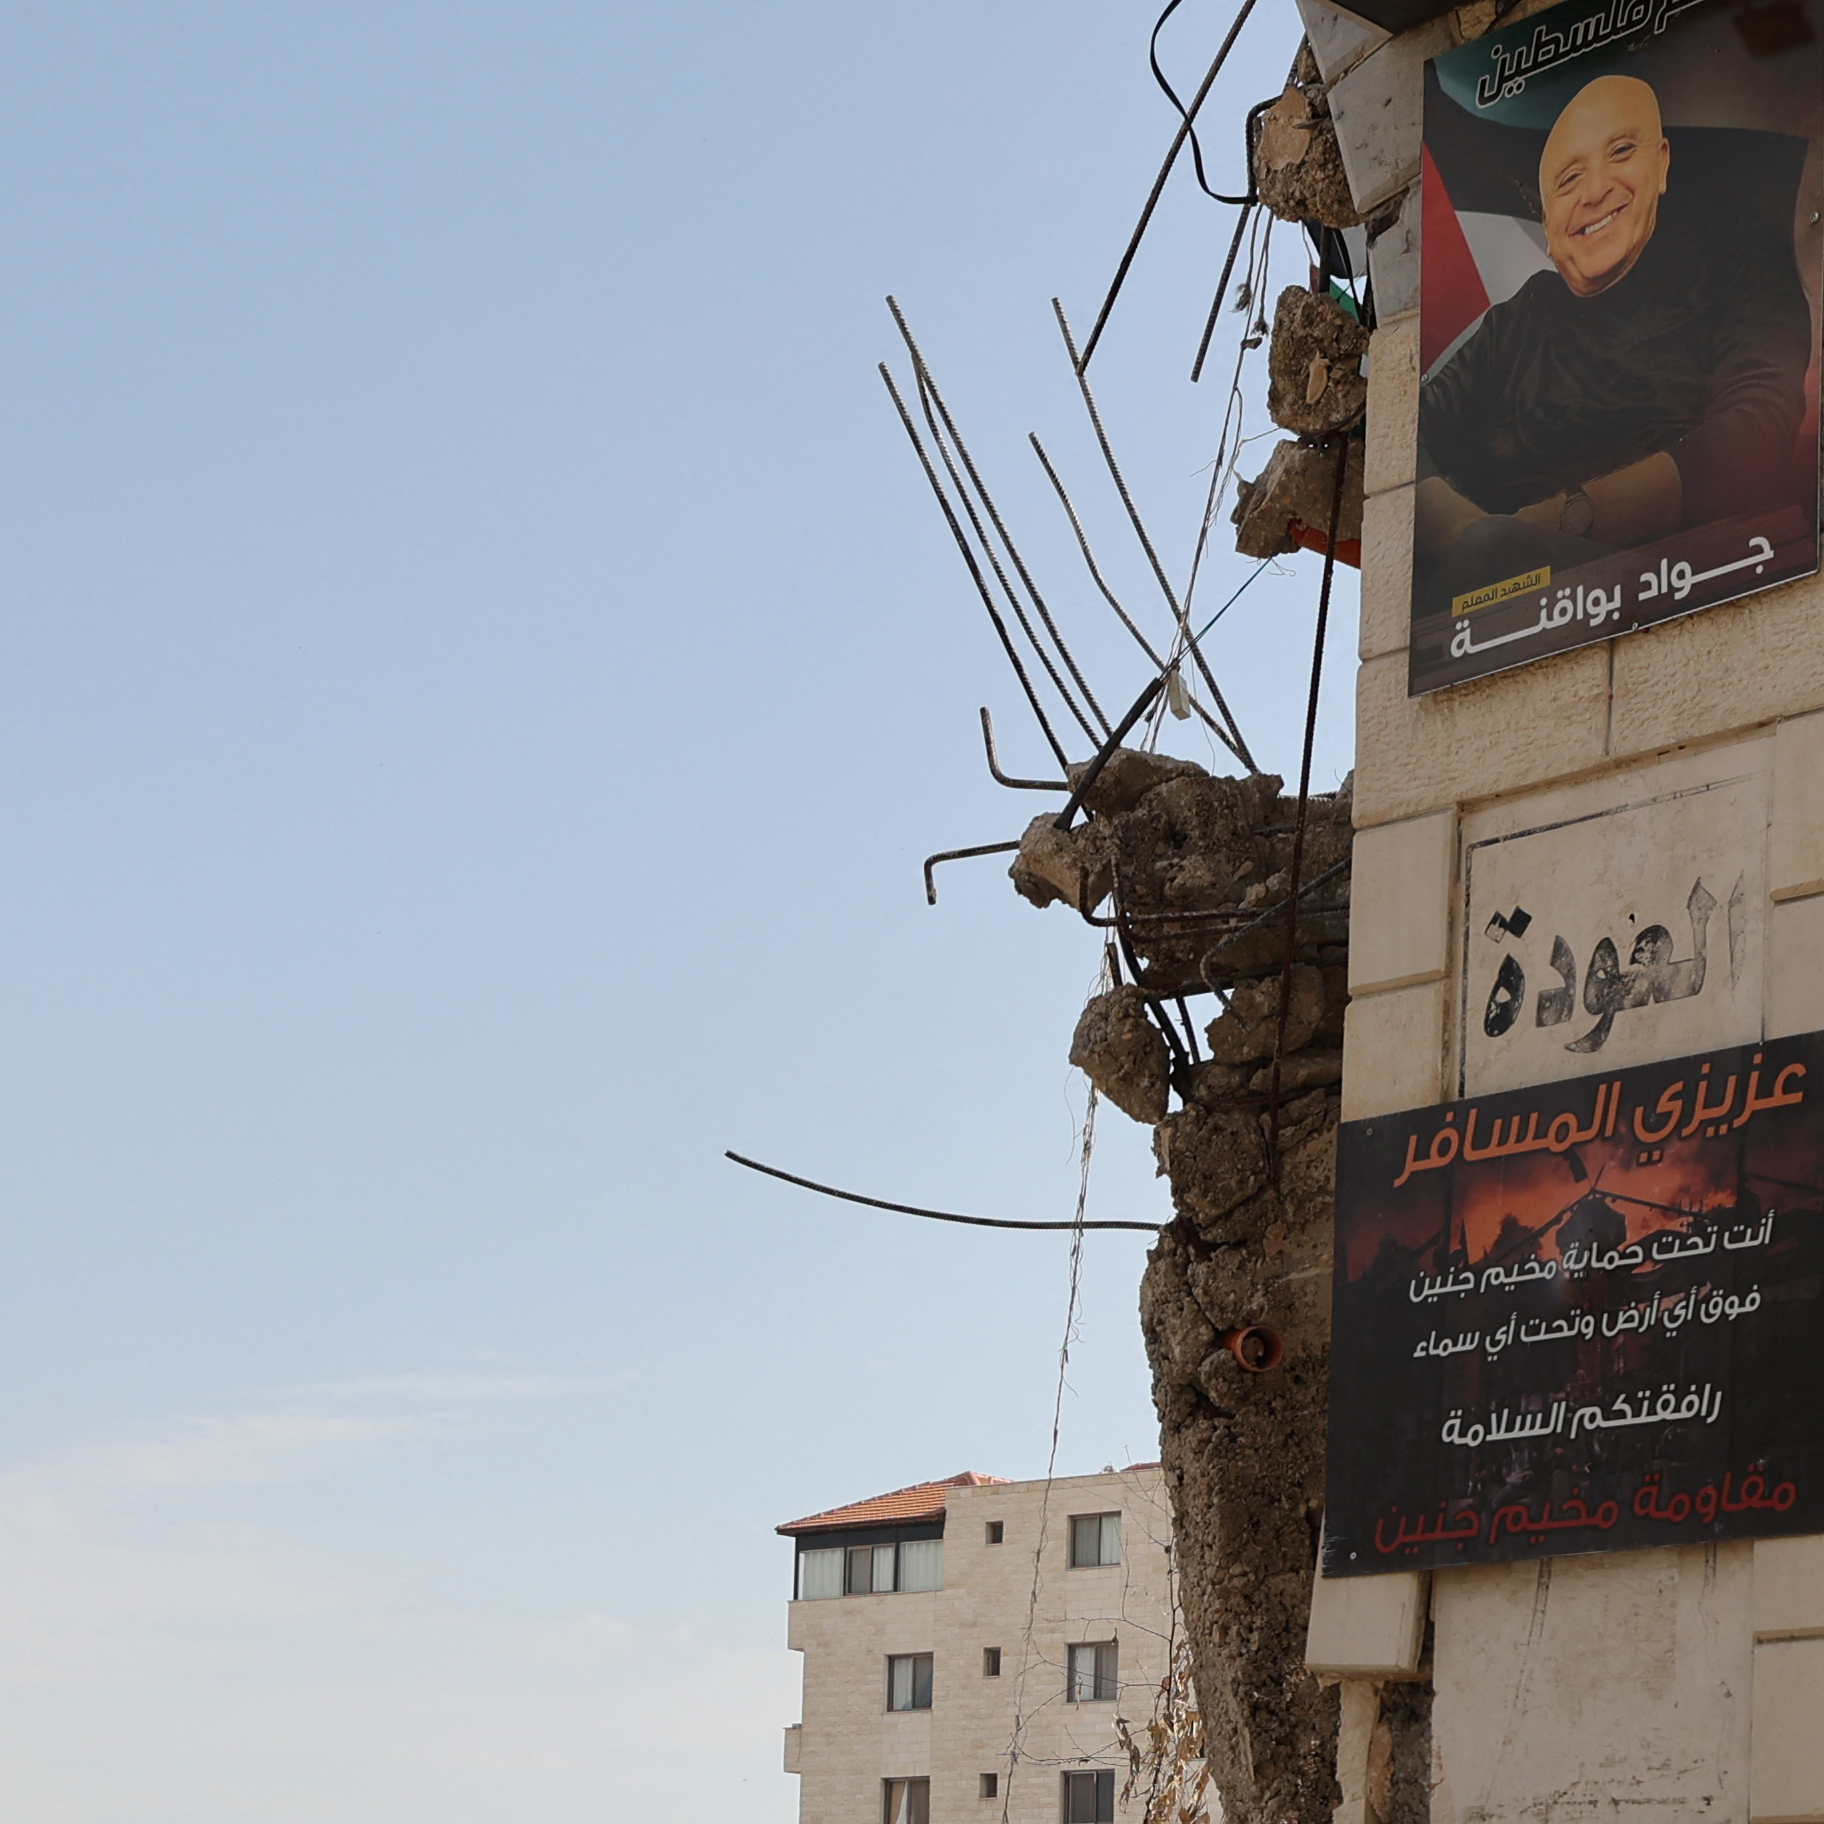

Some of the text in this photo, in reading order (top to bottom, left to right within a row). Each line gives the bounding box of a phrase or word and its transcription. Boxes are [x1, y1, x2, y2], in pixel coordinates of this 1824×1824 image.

[1450, 536, 1774, 658] جواد بواقنة
[1461, 573, 1541, 612] الشهيد المعلم
[1393, 1053, 1807, 1188] عزيزي المسافر
[1409, 1209, 1776, 1303] أنت تحت حماية مخيم جنين
[1413, 1284, 1761, 1362] فوق أي أرض وتحت أي سماء
[1441, 1383, 1723, 1447] رافقتكم السلامة
[1376, 1464, 1797, 1555] مقاومة مخيم جنين
